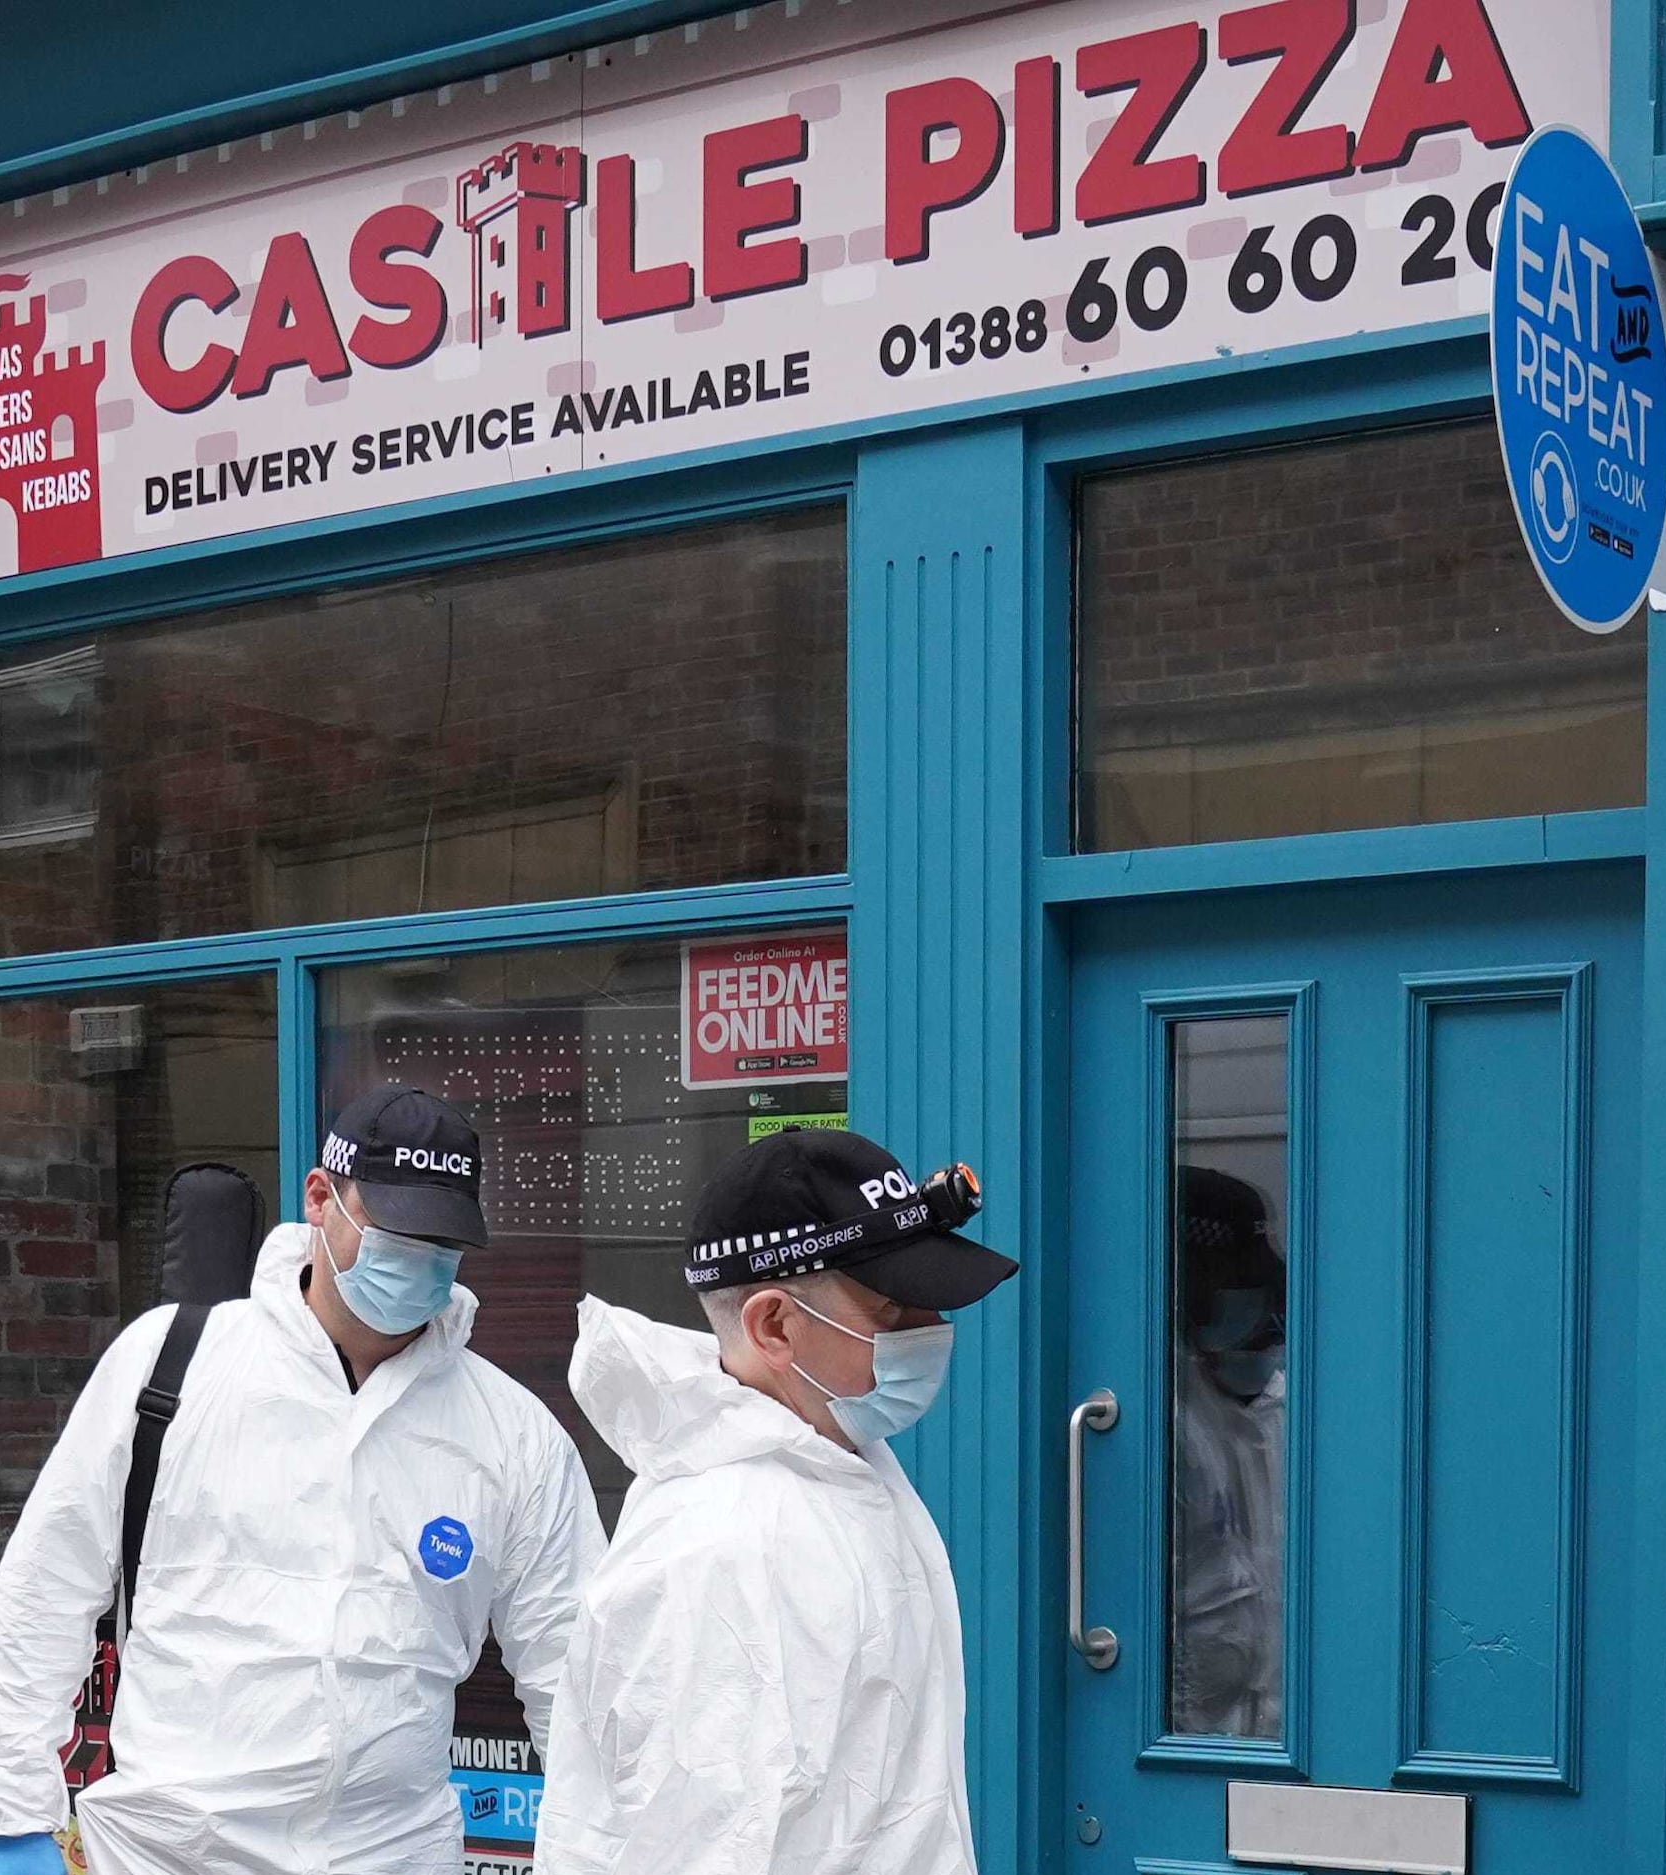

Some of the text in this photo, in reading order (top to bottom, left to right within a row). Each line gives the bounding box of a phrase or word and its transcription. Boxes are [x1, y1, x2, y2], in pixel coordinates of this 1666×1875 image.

[131, 0, 1534, 416] CASTLE PIZZA
[879, 300, 1049, 377] 01388
[1066, 247, 1188, 344] 60
[1229, 215, 1357, 315] 60
[1515, 190, 1650, 353] EAT AND
[1515, 315, 1654, 467] REPEAT
[145, 351, 811, 517] DELIVERY SERVICE AVAILABLE
[22, 468, 91, 514] KEBABS
[1594, 455, 1647, 513] .CO.UK
[733, 946, 816, 963] Order Online At
[698, 958, 847, 1012] FEEDME
[696, 1002, 835, 1054] ONLINE
[442, 1066, 623, 1123] OPEN
[754, 1121, 781, 1132] FOOD
[394, 1147, 472, 1176] POLICE
[481, 1136, 661, 1195] lcome
[859, 1168, 917, 1210] POL
[752, 1251, 776, 1271] AP
[430, 1534, 463, 1559] Tyvek
[452, 1736, 531, 1772] MONEY
[474, 1794, 498, 1814] AND
